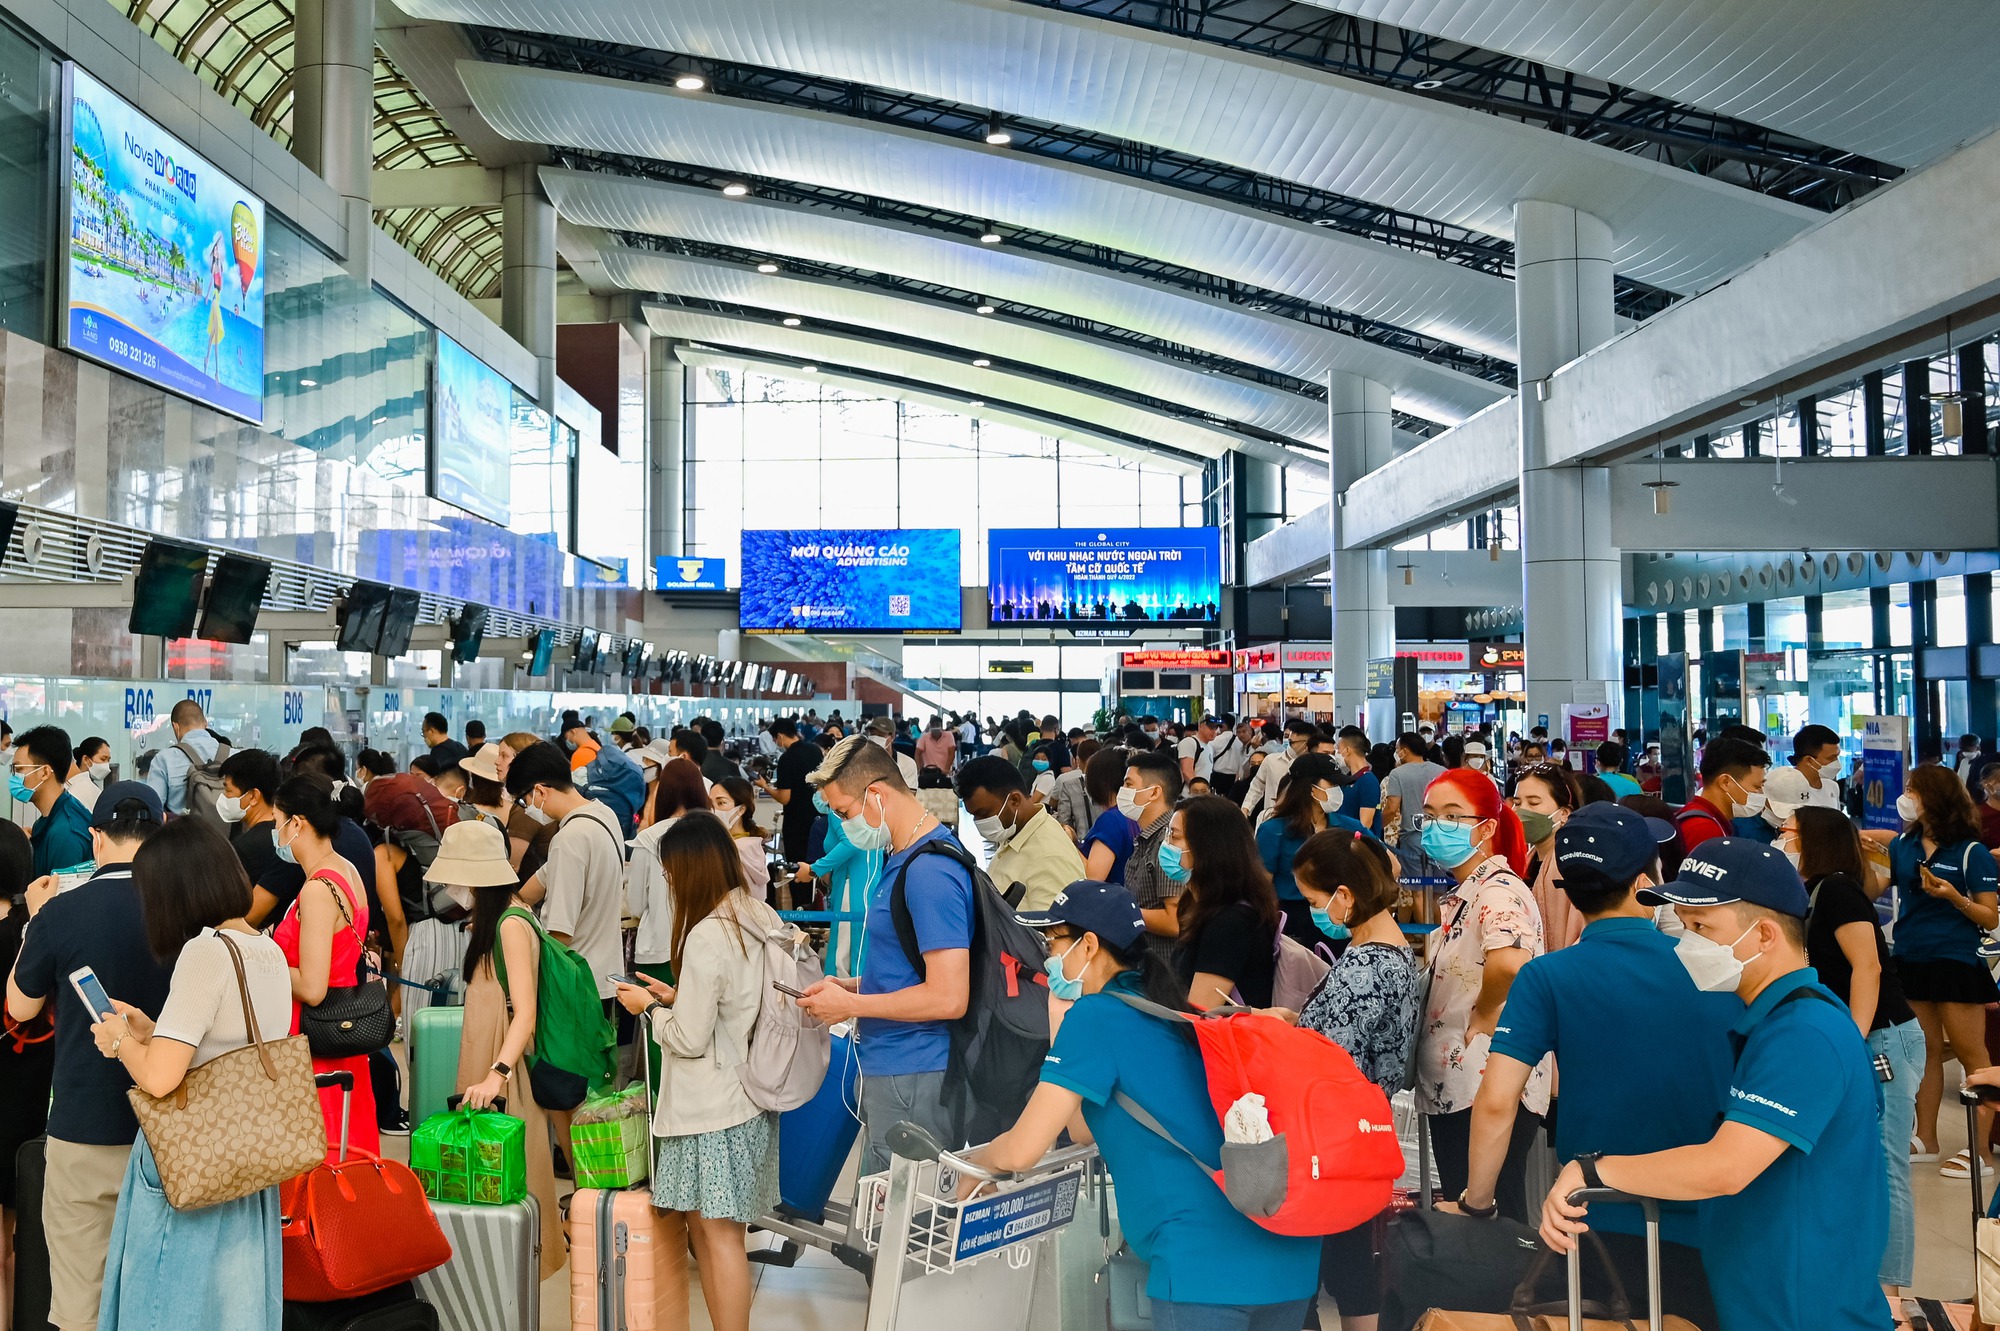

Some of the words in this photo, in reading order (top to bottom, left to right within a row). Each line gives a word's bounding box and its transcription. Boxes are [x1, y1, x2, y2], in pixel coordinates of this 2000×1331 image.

[109, 336, 128, 356] 0938
[129, 346, 142, 363] 221
[143, 352, 157, 370] 226
[791, 543, 820, 558] MỜI
[822, 543, 875, 560] QUẢNG
[878, 543, 910, 557] CÁO
[1028, 551, 1045, 561] VỚI
[1047, 552, 1067, 561] KHU
[1069, 552, 1095, 563] NHẠC
[1096, 550, 1126, 561] NƯỚC
[1127, 550, 1157, 561] NGOÀI
[1158, 550, 1182, 561] TRỜI
[836, 557, 908, 567] ADVERTISING
[1065, 562, 1086, 574] TẦM
[1088, 562, 1102, 574] CỠ
[1104, 562, 1131, 574] QUỐC
[1132, 561, 1146, 574] TẾ
[1073, 573, 1088, 581] HOÀN
[1088, 573, 1106, 581] THÀNH
[1287, 651, 1332, 662] LUCKY
[124, 688, 154, 729] B06
[284, 691, 304, 725] B08
[1865, 721, 1881, 736] NIA
[1866, 779, 1884, 809] 40
[964, 1206, 991, 1224] BIZMAN
[1000, 1196, 1025, 1218] 20.000
[977, 1230, 992, 1247] QUẢNG
[992, 1227, 1002, 1243] CÁO
